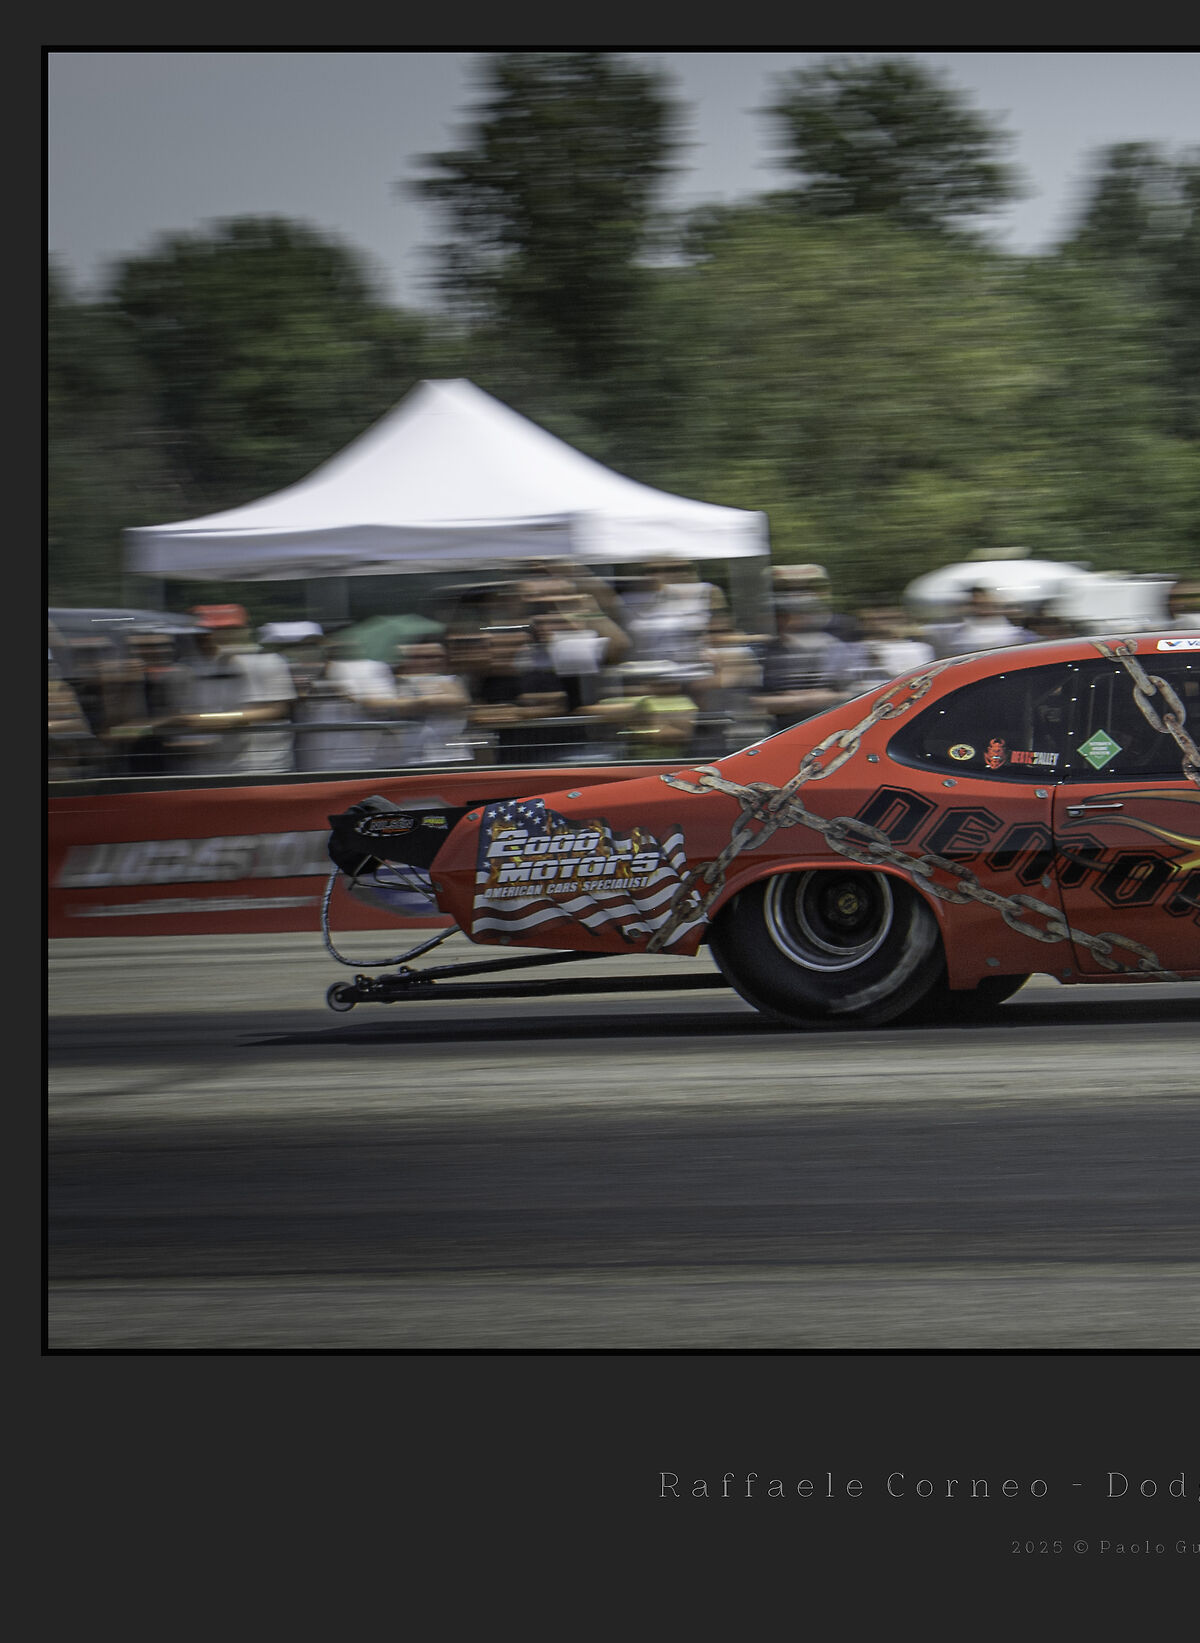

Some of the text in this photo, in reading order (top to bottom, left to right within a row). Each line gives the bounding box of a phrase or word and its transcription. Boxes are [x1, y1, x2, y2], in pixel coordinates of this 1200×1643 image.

[486, 829, 601, 858] 2000
[484, 876, 649, 899] AMERICAN CARS SPECIALIST
